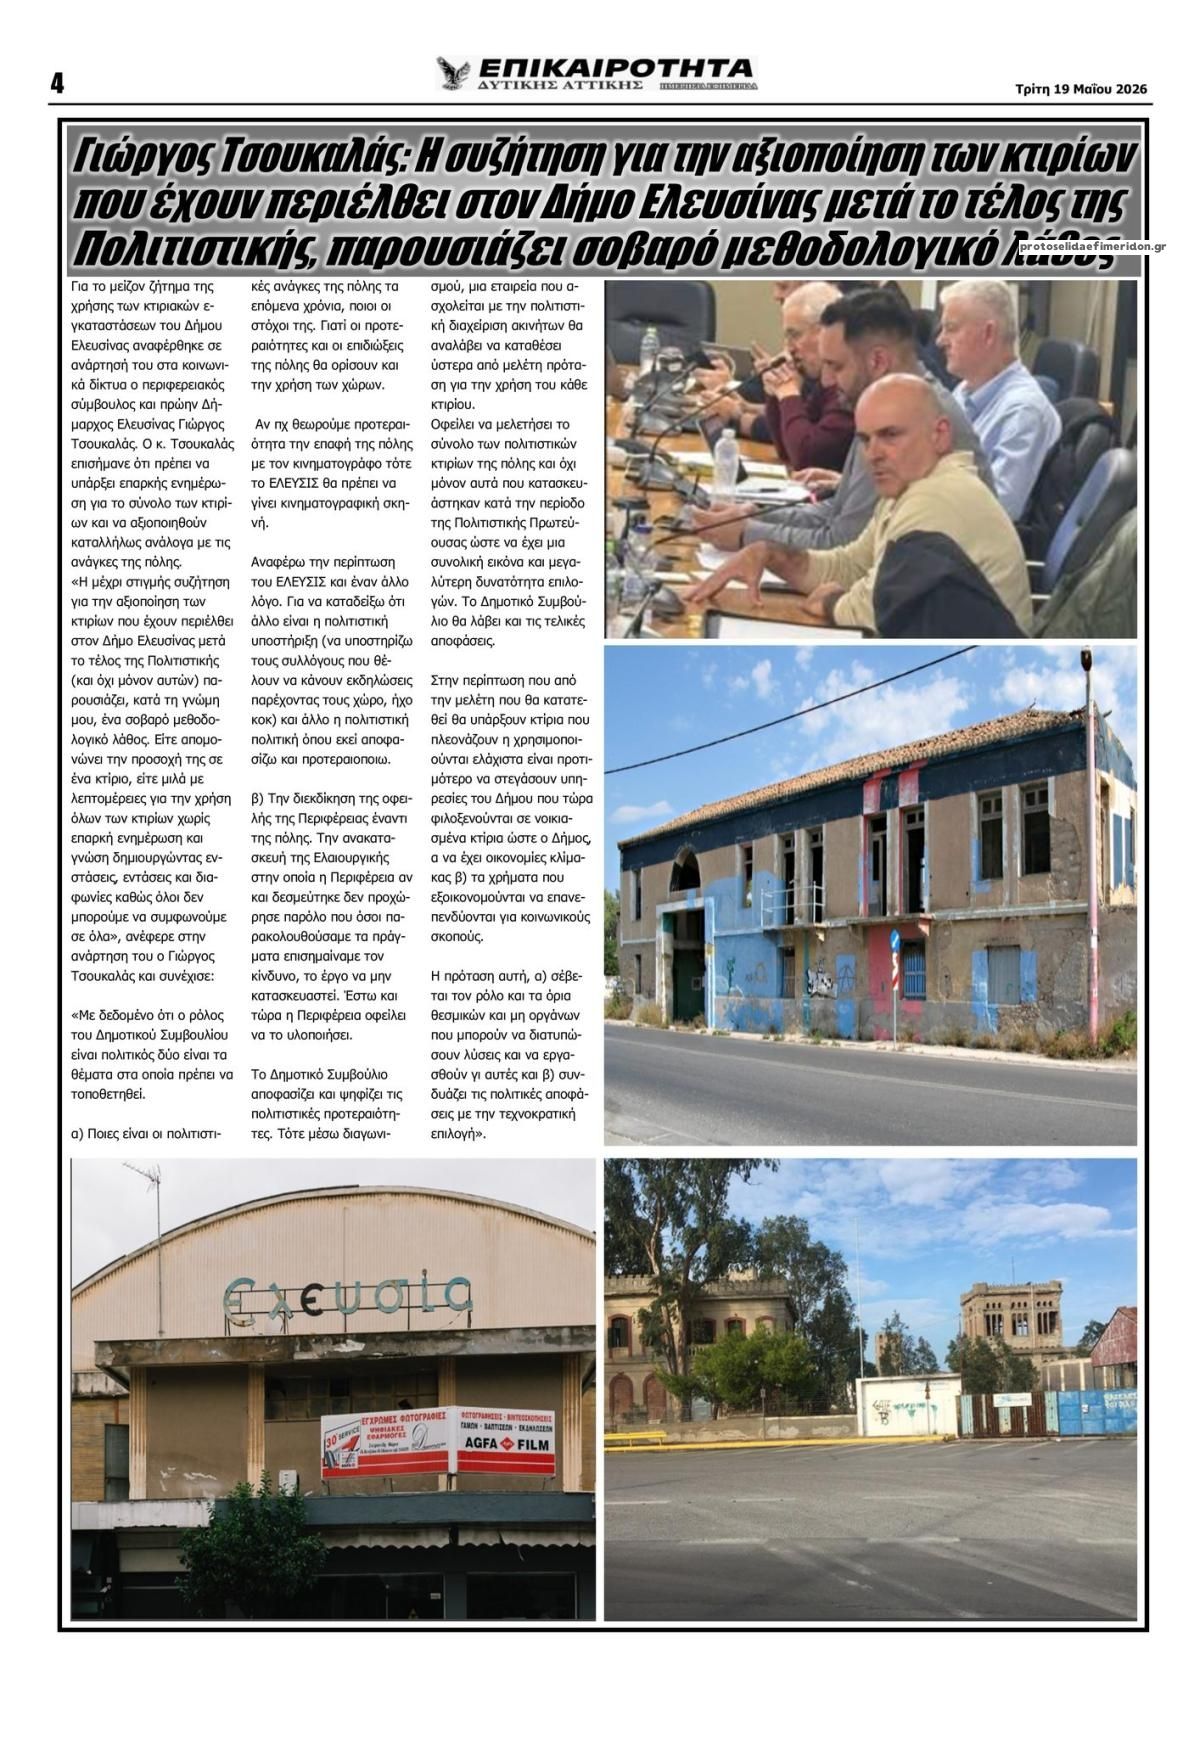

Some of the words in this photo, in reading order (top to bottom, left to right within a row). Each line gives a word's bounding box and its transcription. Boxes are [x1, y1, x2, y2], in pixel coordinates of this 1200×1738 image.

[479, 58, 754, 78] ΕΠΙΚΑΙΡΟΤΗΤΑ
[50, 72, 65, 94] 4
[477, 80, 559, 90] ΔΥΤΙΚΗΣ
[562, 80, 644, 90] ΑΤΤΙΚΗΣ
[1015, 82, 1050, 97] Τρίτη
[1054, 83, 1070, 95] 19
[1073, 82, 1112, 95] Μαΐου
[1116, 83, 1148, 95] 2026
[72, 135, 216, 176] Γιώργος
[220, 135, 412, 176] Τσουκαλάς:
[414, 136, 446, 172] Η
[445, 135, 608, 176] συζήτηση
[612, 142, 670, 176] για
[673, 142, 732, 176] την
[731, 135, 926, 176] αξιοποίηση
[930, 142, 1002, 172] των
[1000, 135, 1139, 176] κτιρίων
[72, 188, 148, 219] που
[150, 182, 265, 223] έχουν
[264, 182, 453, 223] περιέλθει
[455, 188, 542, 219] στον
[540, 182, 636, 223] Δήμο
[638, 182, 823, 222] Ελευσίνας
[822, 182, 916, 223] μετά
[918, 188, 959, 219] το
[963, 182, 1066, 223] τέλος
[1070, 188, 1129, 223] της
[72, 229, 318, 270] Πολιτιστικής,
[325, 229, 568, 270] παρουσιάζει
[572, 229, 720, 270] σοβαρό
[720, 229, 1000, 270] μεθοδολογικό
[71, 280, 89, 292] Για
[92, 282, 106, 292] το
[109, 279, 146, 295] μείζον
[148, 279, 190, 295] ζήτημα
[193, 282, 214, 295] της
[251, 279, 271, 295] κές
[273, 279, 321, 295] ανάγκες
[323, 282, 345, 295] της
[347, 279, 382, 295] πόλης
[384, 282, 399, 292] τα
[430, 298, 485, 314] σχολείται
[488, 302, 503, 314] με
[505, 302, 527, 314] την
[530, 299, 585, 312] πολιτιστι-
[71, 338, 130, 354] Ελευσίνας
[132, 338, 205, 354] αναφέρθηκε
[207, 341, 222, 352] σε
[251, 338, 309, 354] ραιότητες
[311, 342, 329, 351] και
[331, 342, 343, 352] οι
[346, 338, 404, 354] επιδιώξεις
[431, 358, 473, 374] ύστερα
[476, 358, 500, 371] από
[502, 358, 543, 374] μελέτη
[546, 358, 587, 373] πρότα-
[70, 436, 138, 452] Τσουκαλάς.
[142, 438, 153, 450] Ο
[156, 440, 166, 449] κ.
[170, 436, 235, 452] Τσουκαλάς
[250, 479, 266, 489] το
[269, 477, 319, 489] ΕΛΕΥΣΙΣ
[322, 476, 338, 489] θα
[341, 476, 379, 491] πρέπει
[381, 479, 397, 489] να
[430, 496, 481, 512] άστηκαν
[484, 496, 512, 509] κατά
[515, 499, 536, 512] την
[539, 496, 585, 511] περίοδο
[71, 535, 142, 551] καταλλήλως
[144, 535, 194, 551] ανάλογα
[197, 538, 212, 551] με
[214, 538, 231, 551] τις
[250, 555, 306, 570] Αναφέρω
[308, 558, 330, 570] την
[333, 555, 396, 570] περίπτωση
[71, 614, 114, 630] κτιρίων
[117, 617, 140, 627] που
[143, 614, 178, 629] έχουν
[181, 614, 234, 629] περιέλθει
[250, 657, 279, 669] τους
[281, 653, 345, 669] συλλόγους
[348, 657, 370, 667] που
[373, 653, 392, 667] θέ-
[430, 674, 459, 689] Στην
[462, 673, 525, 689] περίπτωση
[528, 676, 551, 686] που
[554, 673, 577, 686] από
[431, 732, 499, 748] πλεονάζουν
[502, 735, 510, 748] η
[513, 735, 583, 748] χρησιμοποι-
[70, 791, 147, 807] λεπτομέρειες
[149, 794, 167, 807] για
[170, 795, 192, 807] την
[194, 791, 232, 807] χρήση
[430, 831, 467, 846] σμένα
[470, 831, 504, 847] κτίρια
[506, 831, 538, 844] ώστε
[540, 834, 549, 844] ο
[551, 831, 592, 847] Δήμος,
[250, 850, 287, 866] σκευή
[289, 854, 311, 866] της
[313, 850, 390, 866] Ελαιουργικής
[70, 870, 119, 886] στάσεις,
[122, 870, 173, 885] εντάσεις
[175, 873, 192, 883] και
[195, 870, 219, 883] δια-
[430, 890, 526, 905] εξοικονομούνται
[528, 893, 544, 903] να
[547, 893, 586, 903] επανε-
[251, 952, 280, 965] ματα
[283, 948, 361, 964] επισημαίναμε
[363, 952, 385, 962] τον
[70, 969, 136, 984] Τσουκαλάς
[138, 972, 156, 982] και
[159, 969, 215, 984] συνέχισε:
[251, 988, 340, 1002] κατασκευαστεί.
[343, 989, 377, 1002] Έστω
[380, 992, 398, 1002] και
[430, 1008, 486, 1024] θεσμικών
[489, 1011, 506, 1021] και
[510, 1011, 526, 1024] μη
[528, 1008, 581, 1024] οργάνων
[70, 1047, 98, 1061] είναι
[101, 1047, 155, 1063] πολιτικός
[157, 1047, 180, 1061] δύο
[183, 1047, 210, 1061] είναι
[212, 1051, 228, 1061] τα
[250, 1087, 315, 1102] αποφασίζει
[319, 1090, 336, 1100] και
[339, 1087, 383, 1102] ψηφίζει
[386, 1090, 403, 1102] τις
[430, 1087, 467, 1102] δυάζει
[470, 1090, 487, 1102] τις
[490, 1087, 543, 1102] πολιτικές
[545, 1087, 589, 1102] αποφά-
[361, 1415, 398, 1426] ΕΓΧΡΩΜΕΣ
[399, 1411, 446, 1423] ΦΩΤΟΓΡΑΦΙΕΣ
[338, 1424, 361, 1441] SERVICE
[465, 1436, 498, 1449] AGFA
[517, 1439, 549, 1451] FILM
